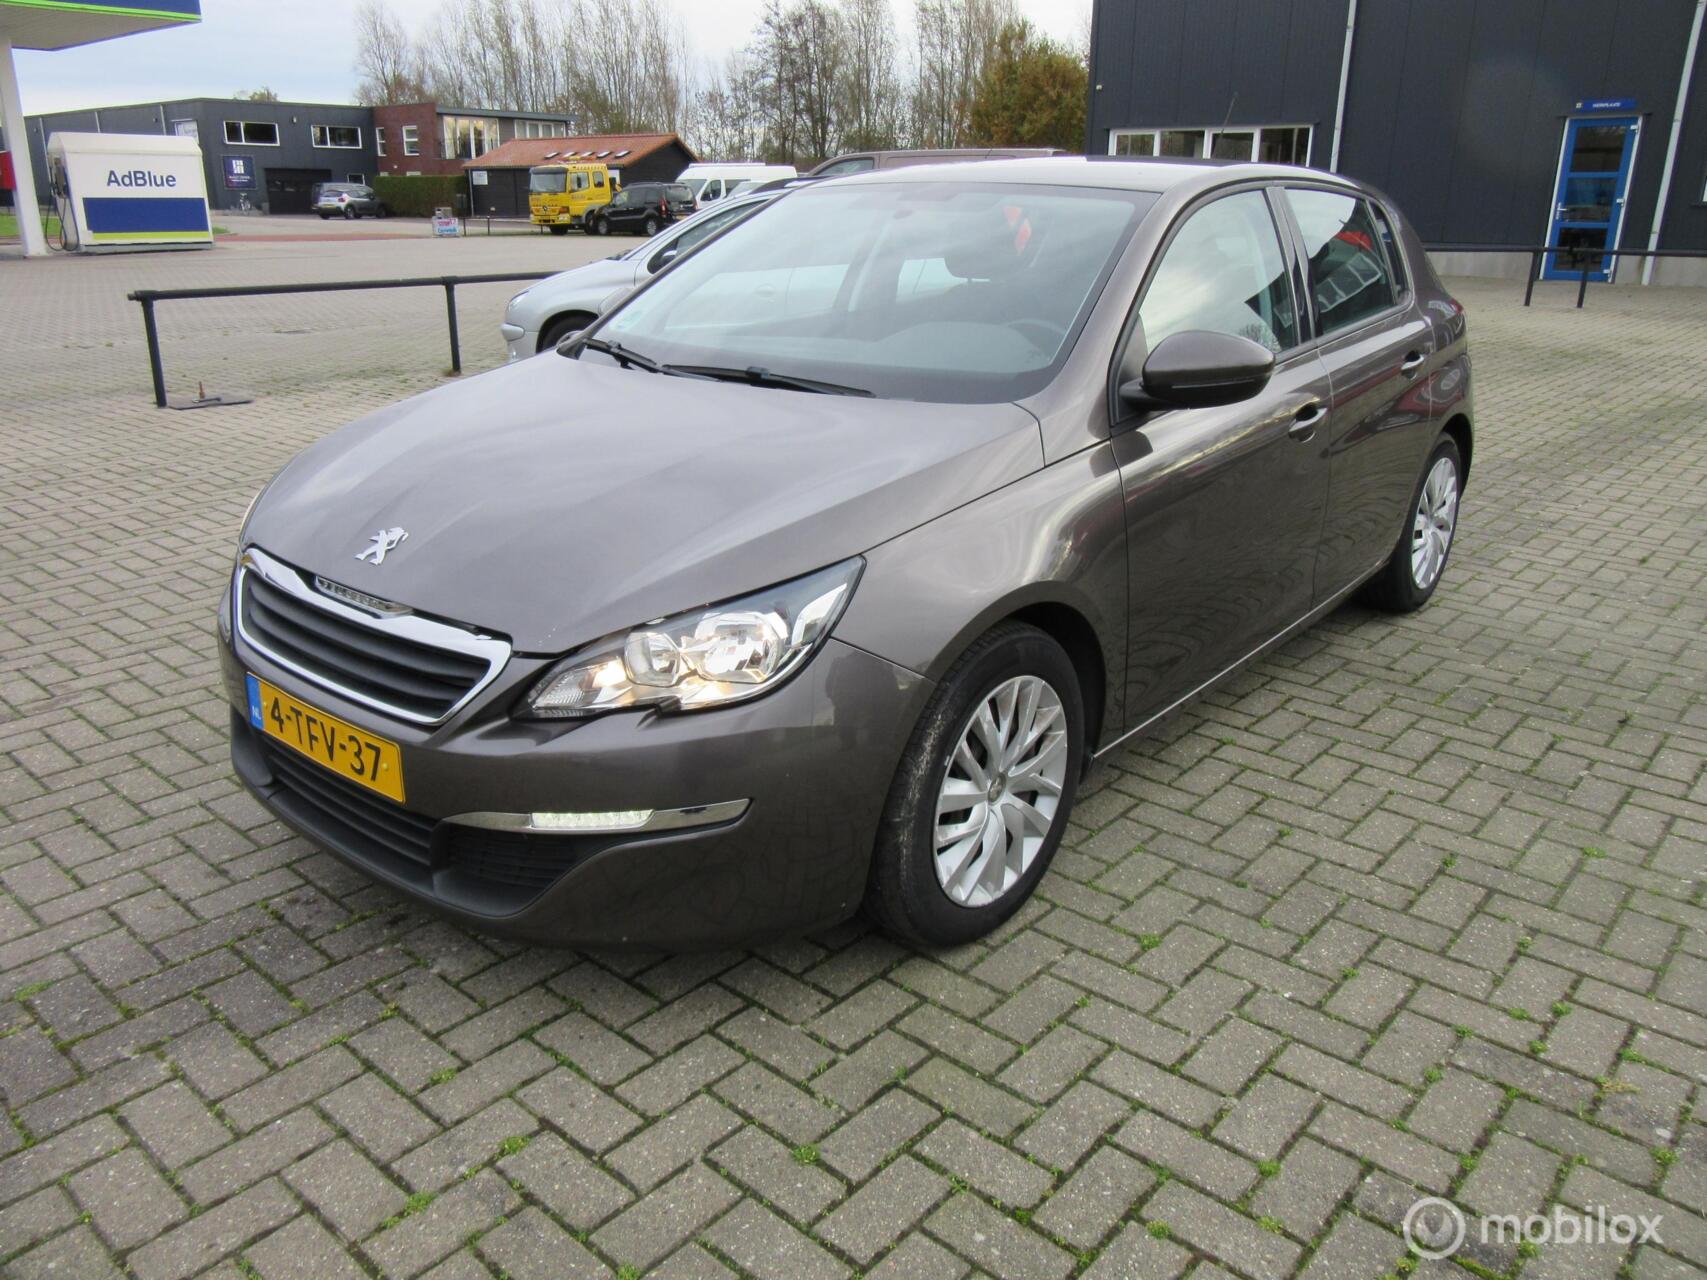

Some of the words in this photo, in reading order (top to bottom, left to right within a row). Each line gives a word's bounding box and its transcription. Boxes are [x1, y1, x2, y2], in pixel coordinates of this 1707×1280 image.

[107, 170, 176, 187] AdBlue
[252, 705, 261, 720] NL
[270, 697, 381, 782] 4-TFV-37
